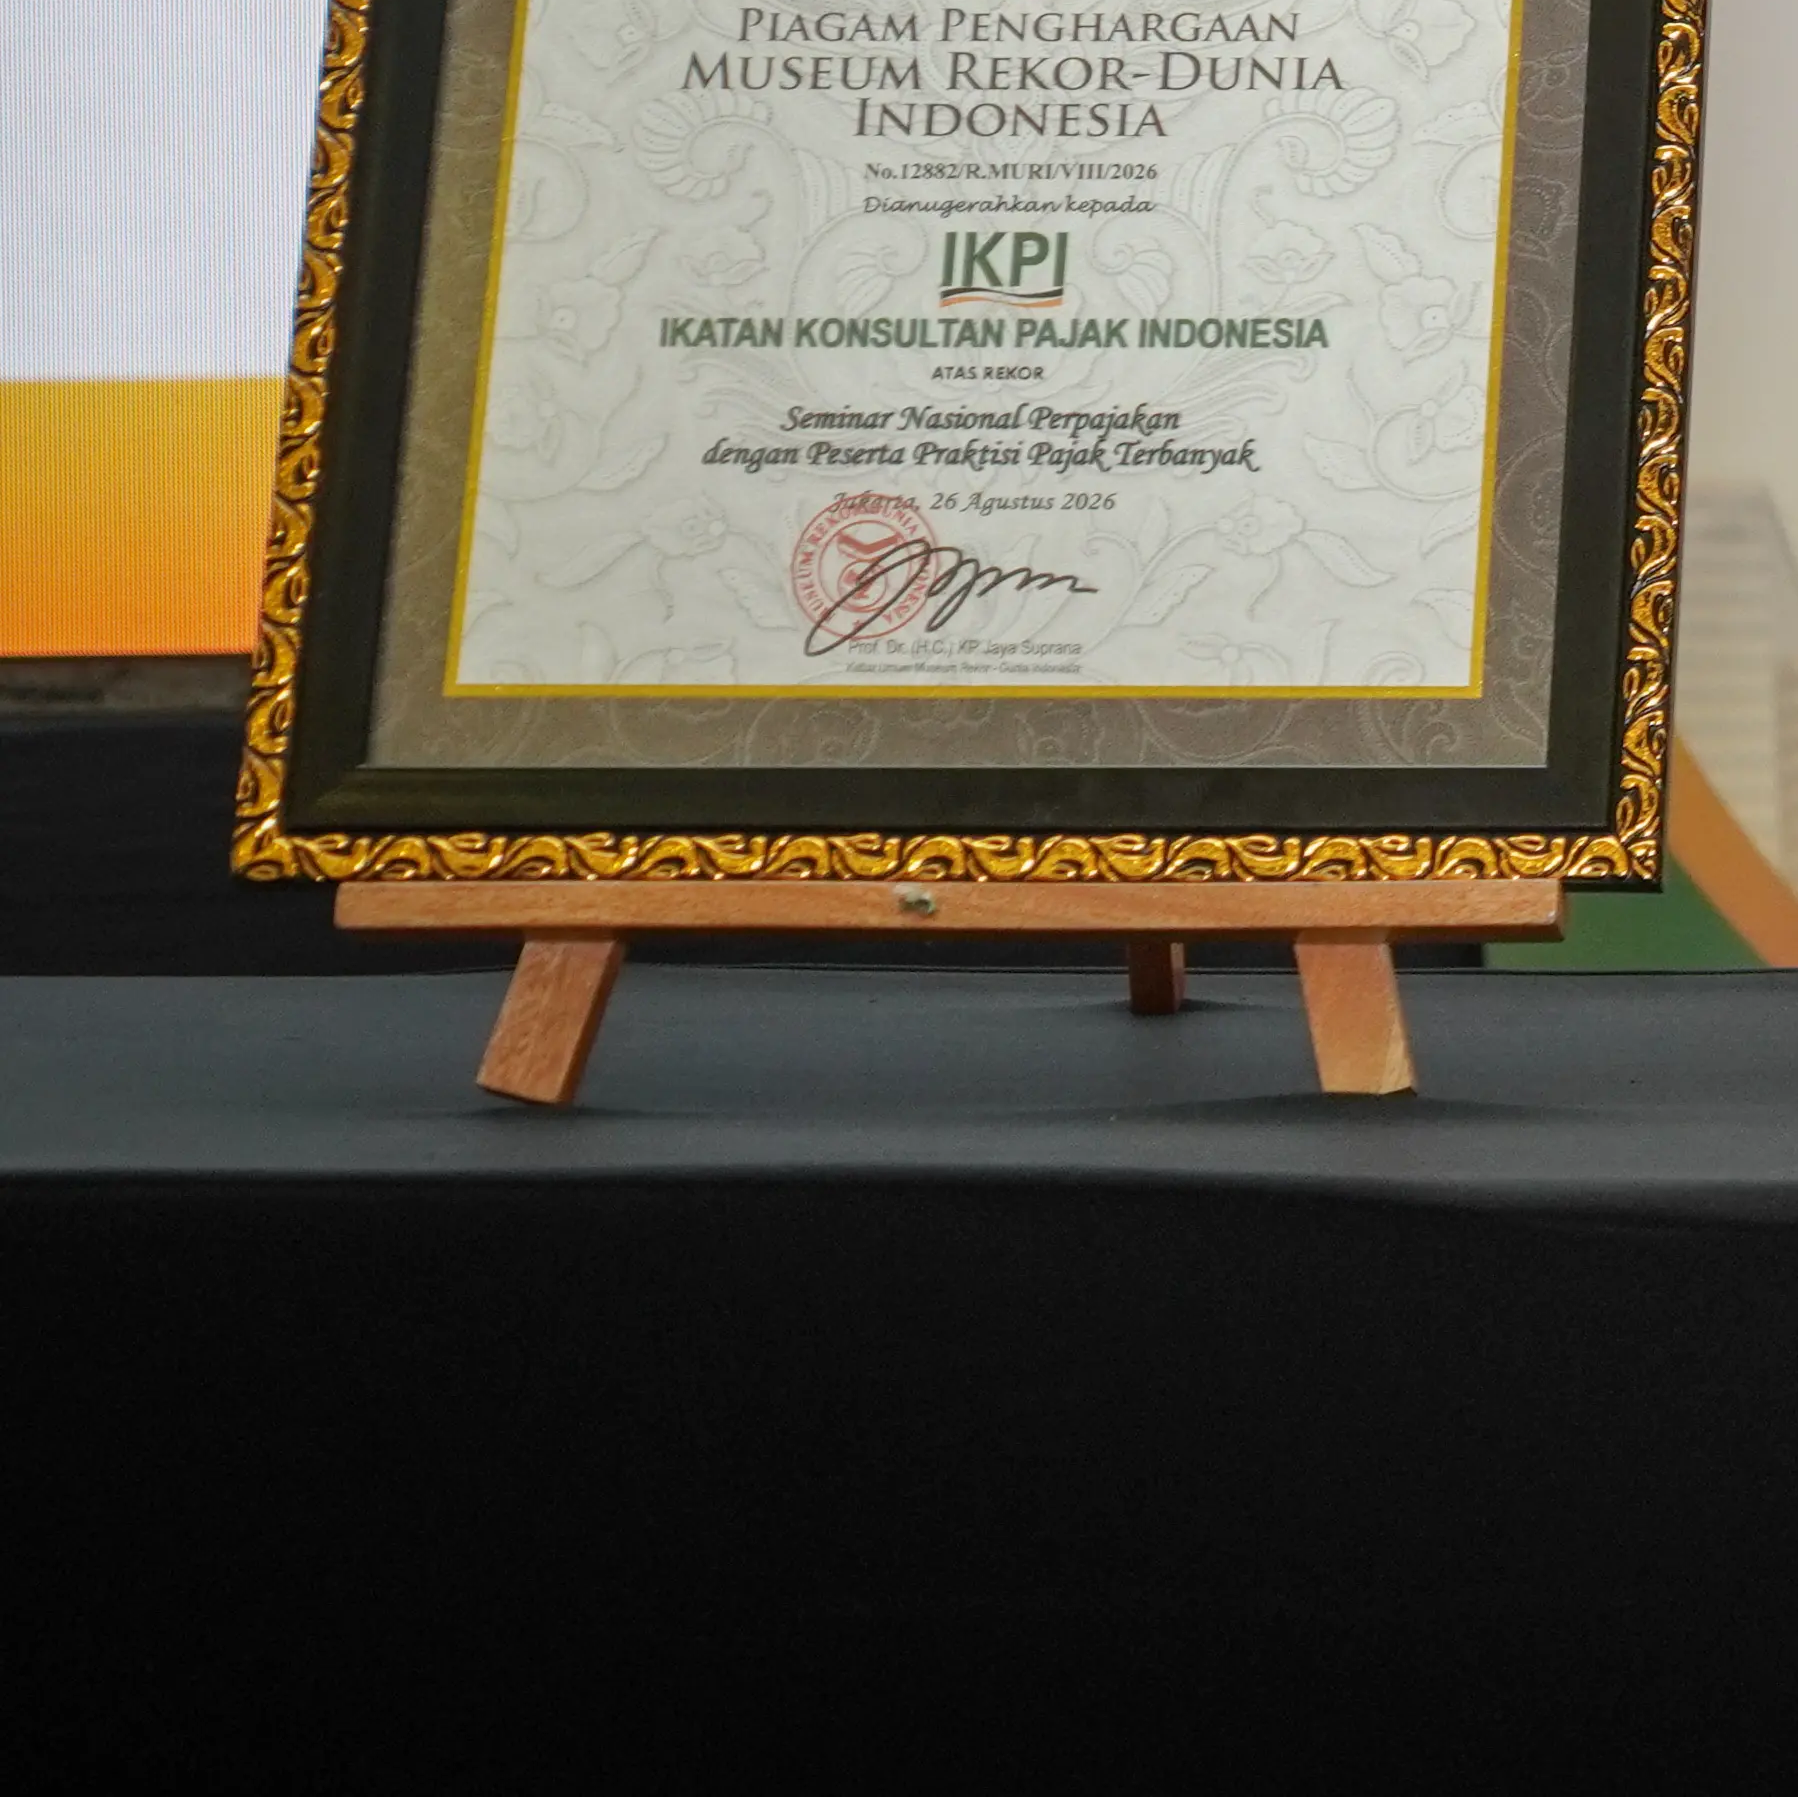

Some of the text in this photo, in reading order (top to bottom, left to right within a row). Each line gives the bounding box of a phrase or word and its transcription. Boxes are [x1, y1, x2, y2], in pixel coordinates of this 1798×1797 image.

[863, 194, 1158, 219] Dianugerahkan kepada
[942, 231, 1068, 289] IKPI
[659, 316, 1329, 349] IKATAN KONSULTAN PAJAK INDONESIA
[931, 365, 1044, 381] ATAS REKOR
[779, 402, 1181, 446] Seminar Nasional Perpajakan
[701, 435, 1261, 475] dengan Peserta Praktisi Pajak Terbanyak
[930, 492, 959, 511] 26
[964, 491, 1056, 517] Agustus
[1061, 492, 1118, 511] 2026
[983, 640, 1017, 658] Jaya
[1020, 639, 1082, 658] Suprana
